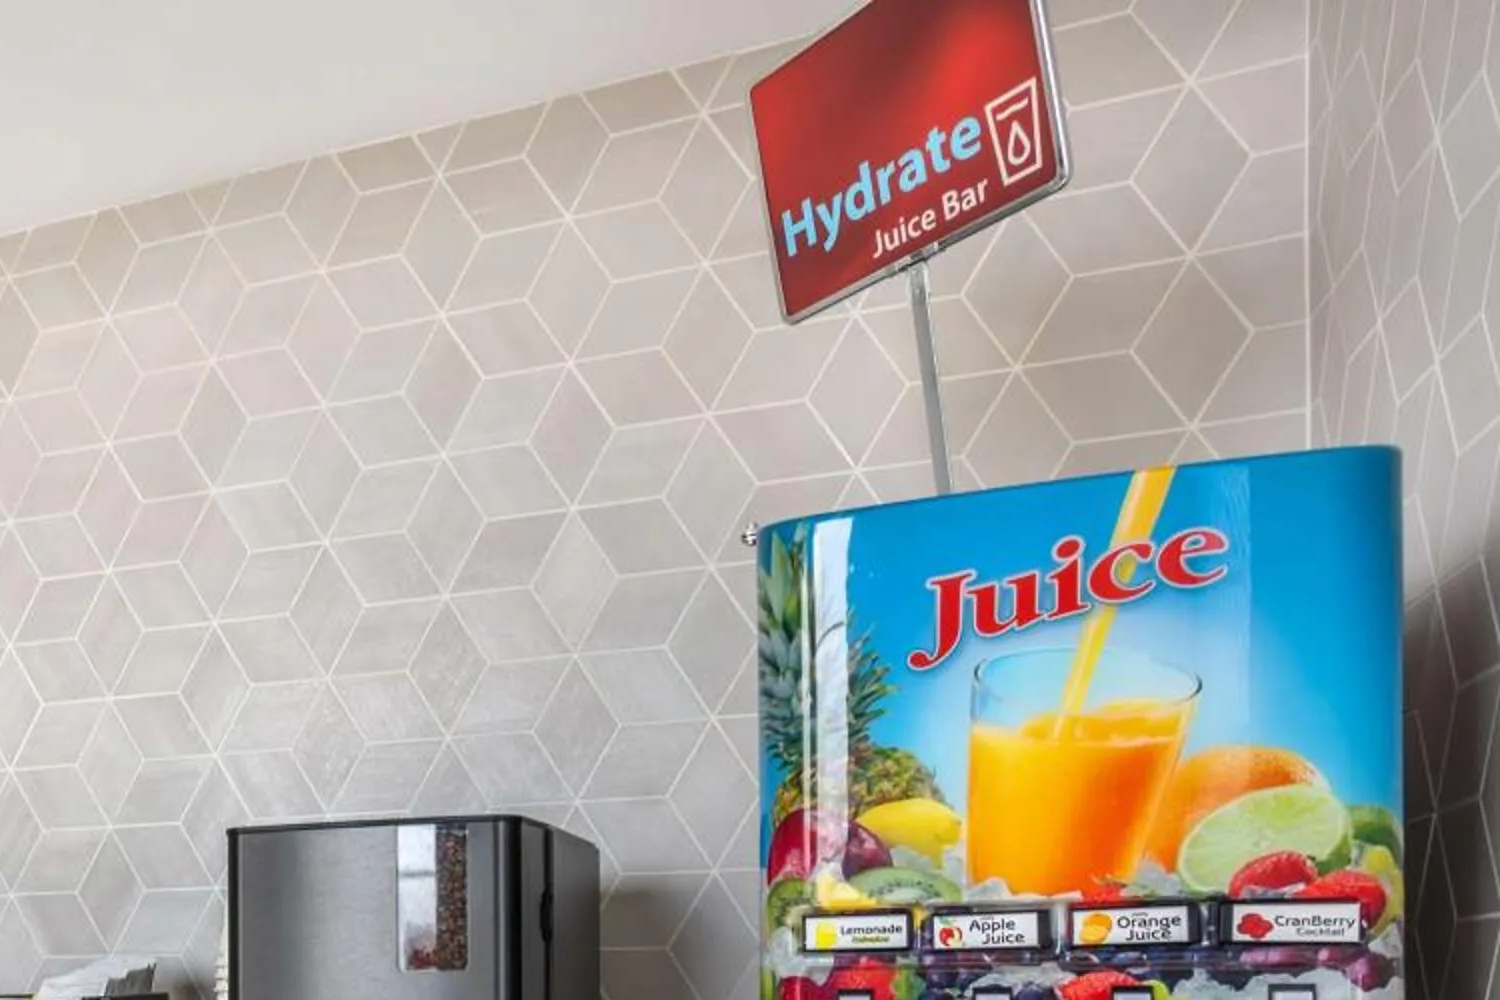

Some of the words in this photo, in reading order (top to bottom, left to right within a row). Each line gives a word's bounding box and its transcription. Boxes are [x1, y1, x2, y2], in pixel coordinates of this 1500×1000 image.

[781, 115, 982, 257] Hydrate
[872, 208, 937, 259] Juice
[941, 178, 988, 221] Bar
[907, 526, 1230, 671] Juice
[840, 923, 903, 936] Lemonade
[969, 916, 1017, 935] Apple
[1117, 914, 1182, 931] Orange
[1275, 914, 1357, 934] CranBerry
[981, 930, 1026, 945] Juice
[1126, 927, 1172, 942] Juice
